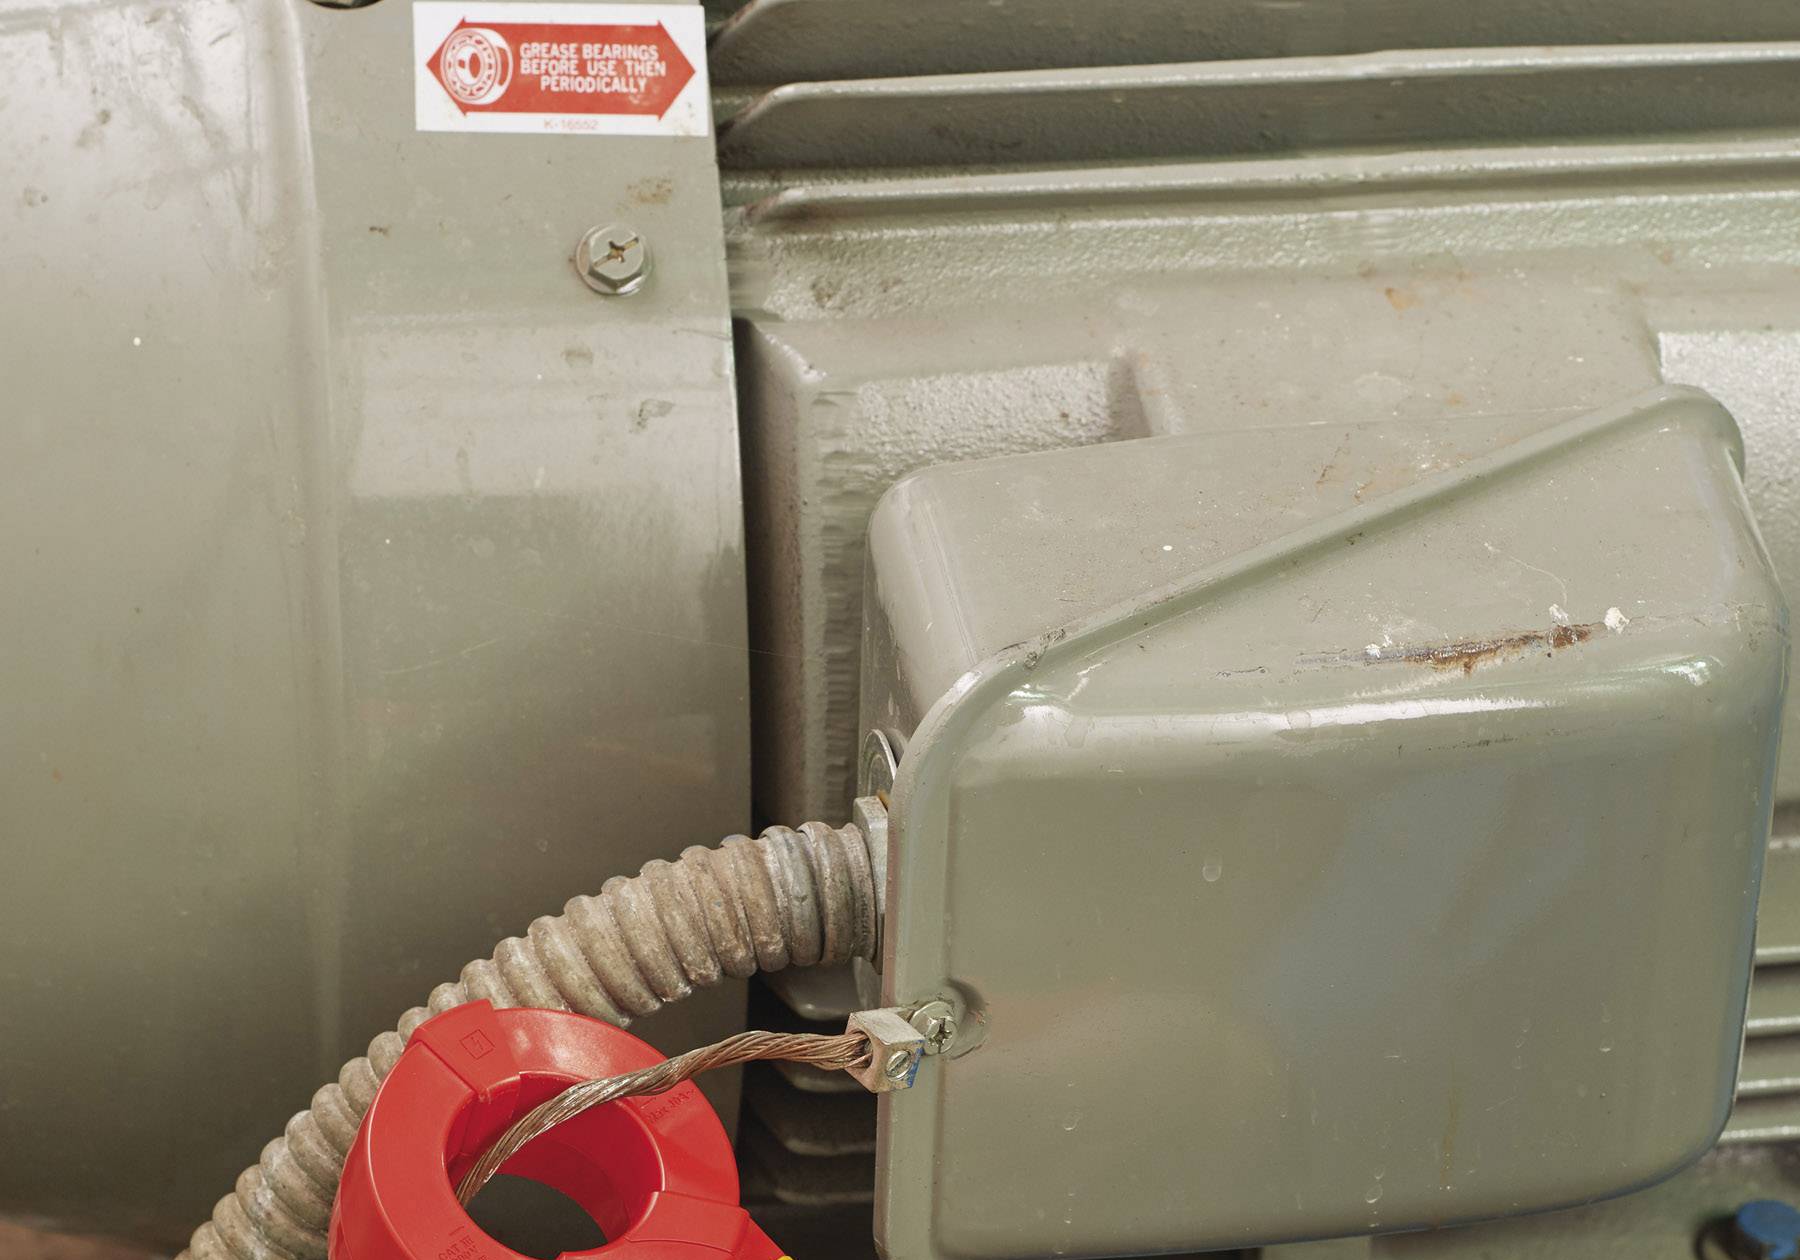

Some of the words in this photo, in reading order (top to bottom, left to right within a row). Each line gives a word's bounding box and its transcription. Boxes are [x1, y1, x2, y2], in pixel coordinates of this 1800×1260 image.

[520, 43, 578, 60] GREASE
[582, 44, 659, 60] BEARINGS
[520, 59, 578, 76] BEFORE
[587, 61, 617, 77] USE
[625, 61, 666, 77] THEN
[540, 75, 648, 93] PERIODICALLY
